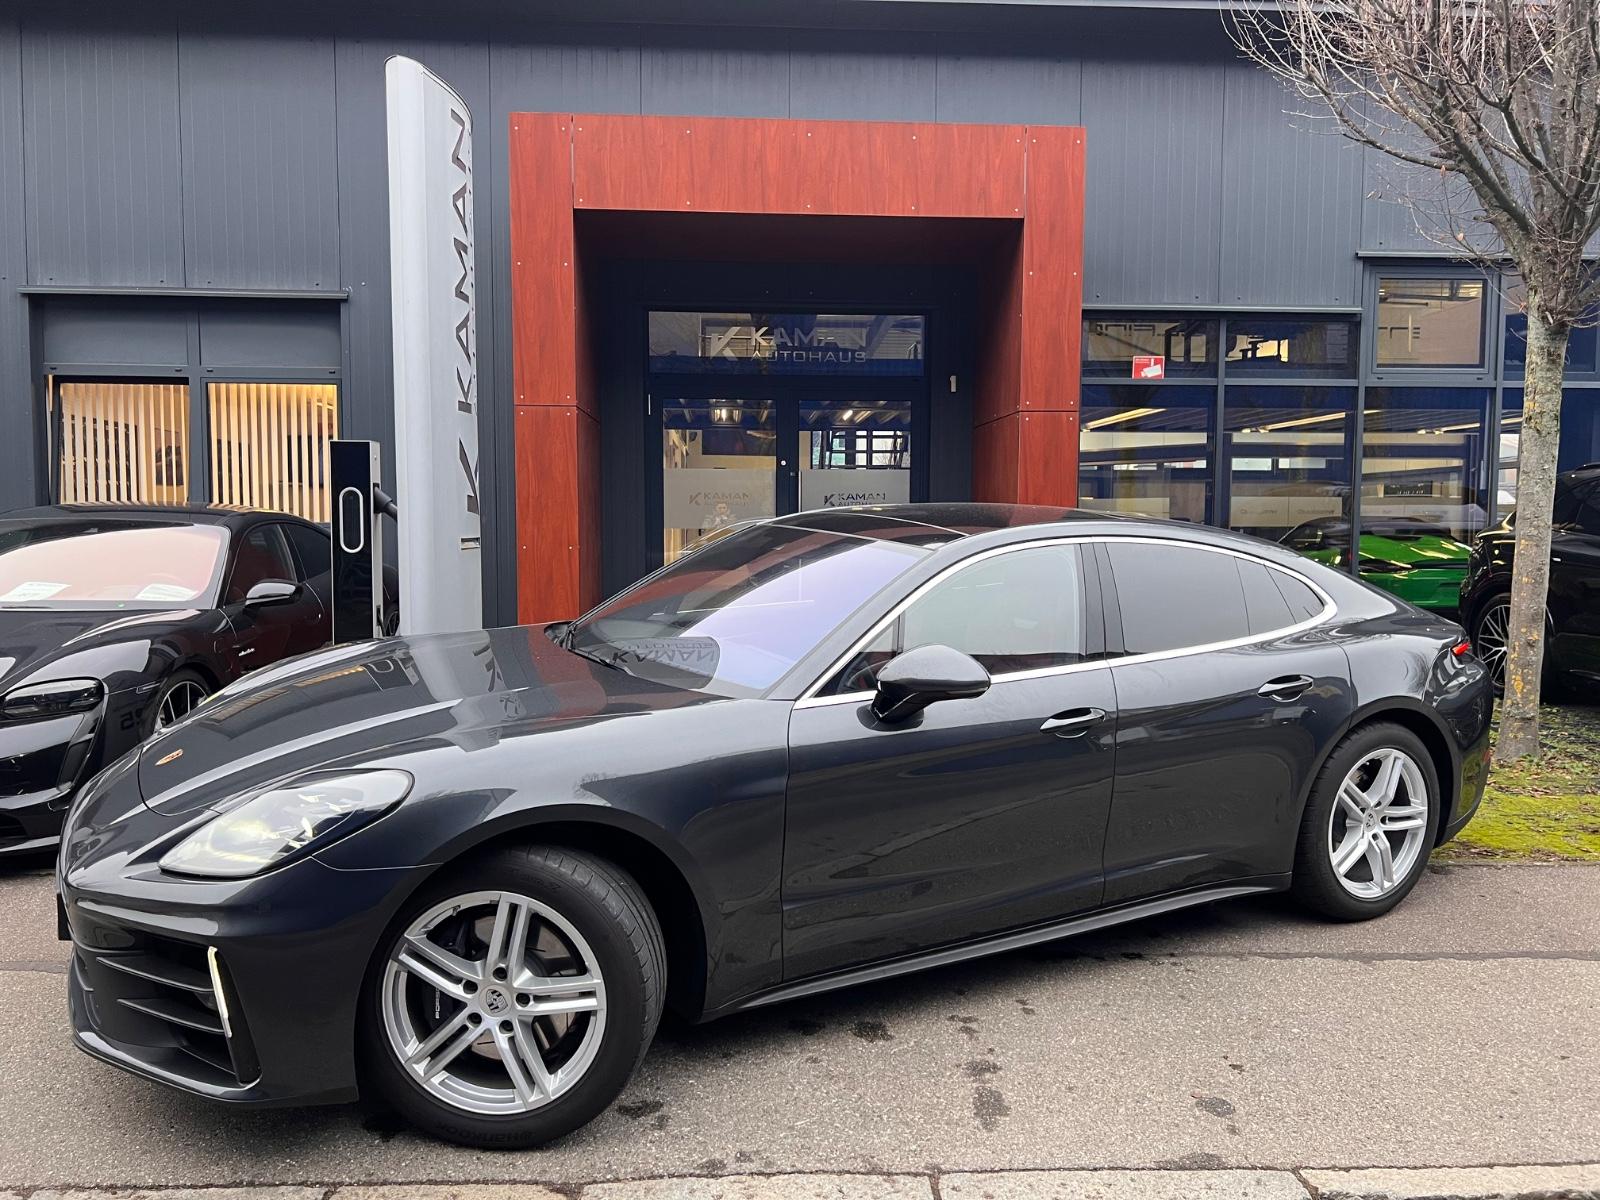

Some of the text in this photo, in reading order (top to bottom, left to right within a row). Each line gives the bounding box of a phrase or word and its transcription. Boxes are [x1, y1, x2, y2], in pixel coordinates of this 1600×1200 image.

[451, 107, 471, 415] KAMAN
[751, 326, 867, 348] KAMAN
[751, 351, 867, 362] AUTOHAUS
[838, 492, 886, 501] KAMAN
